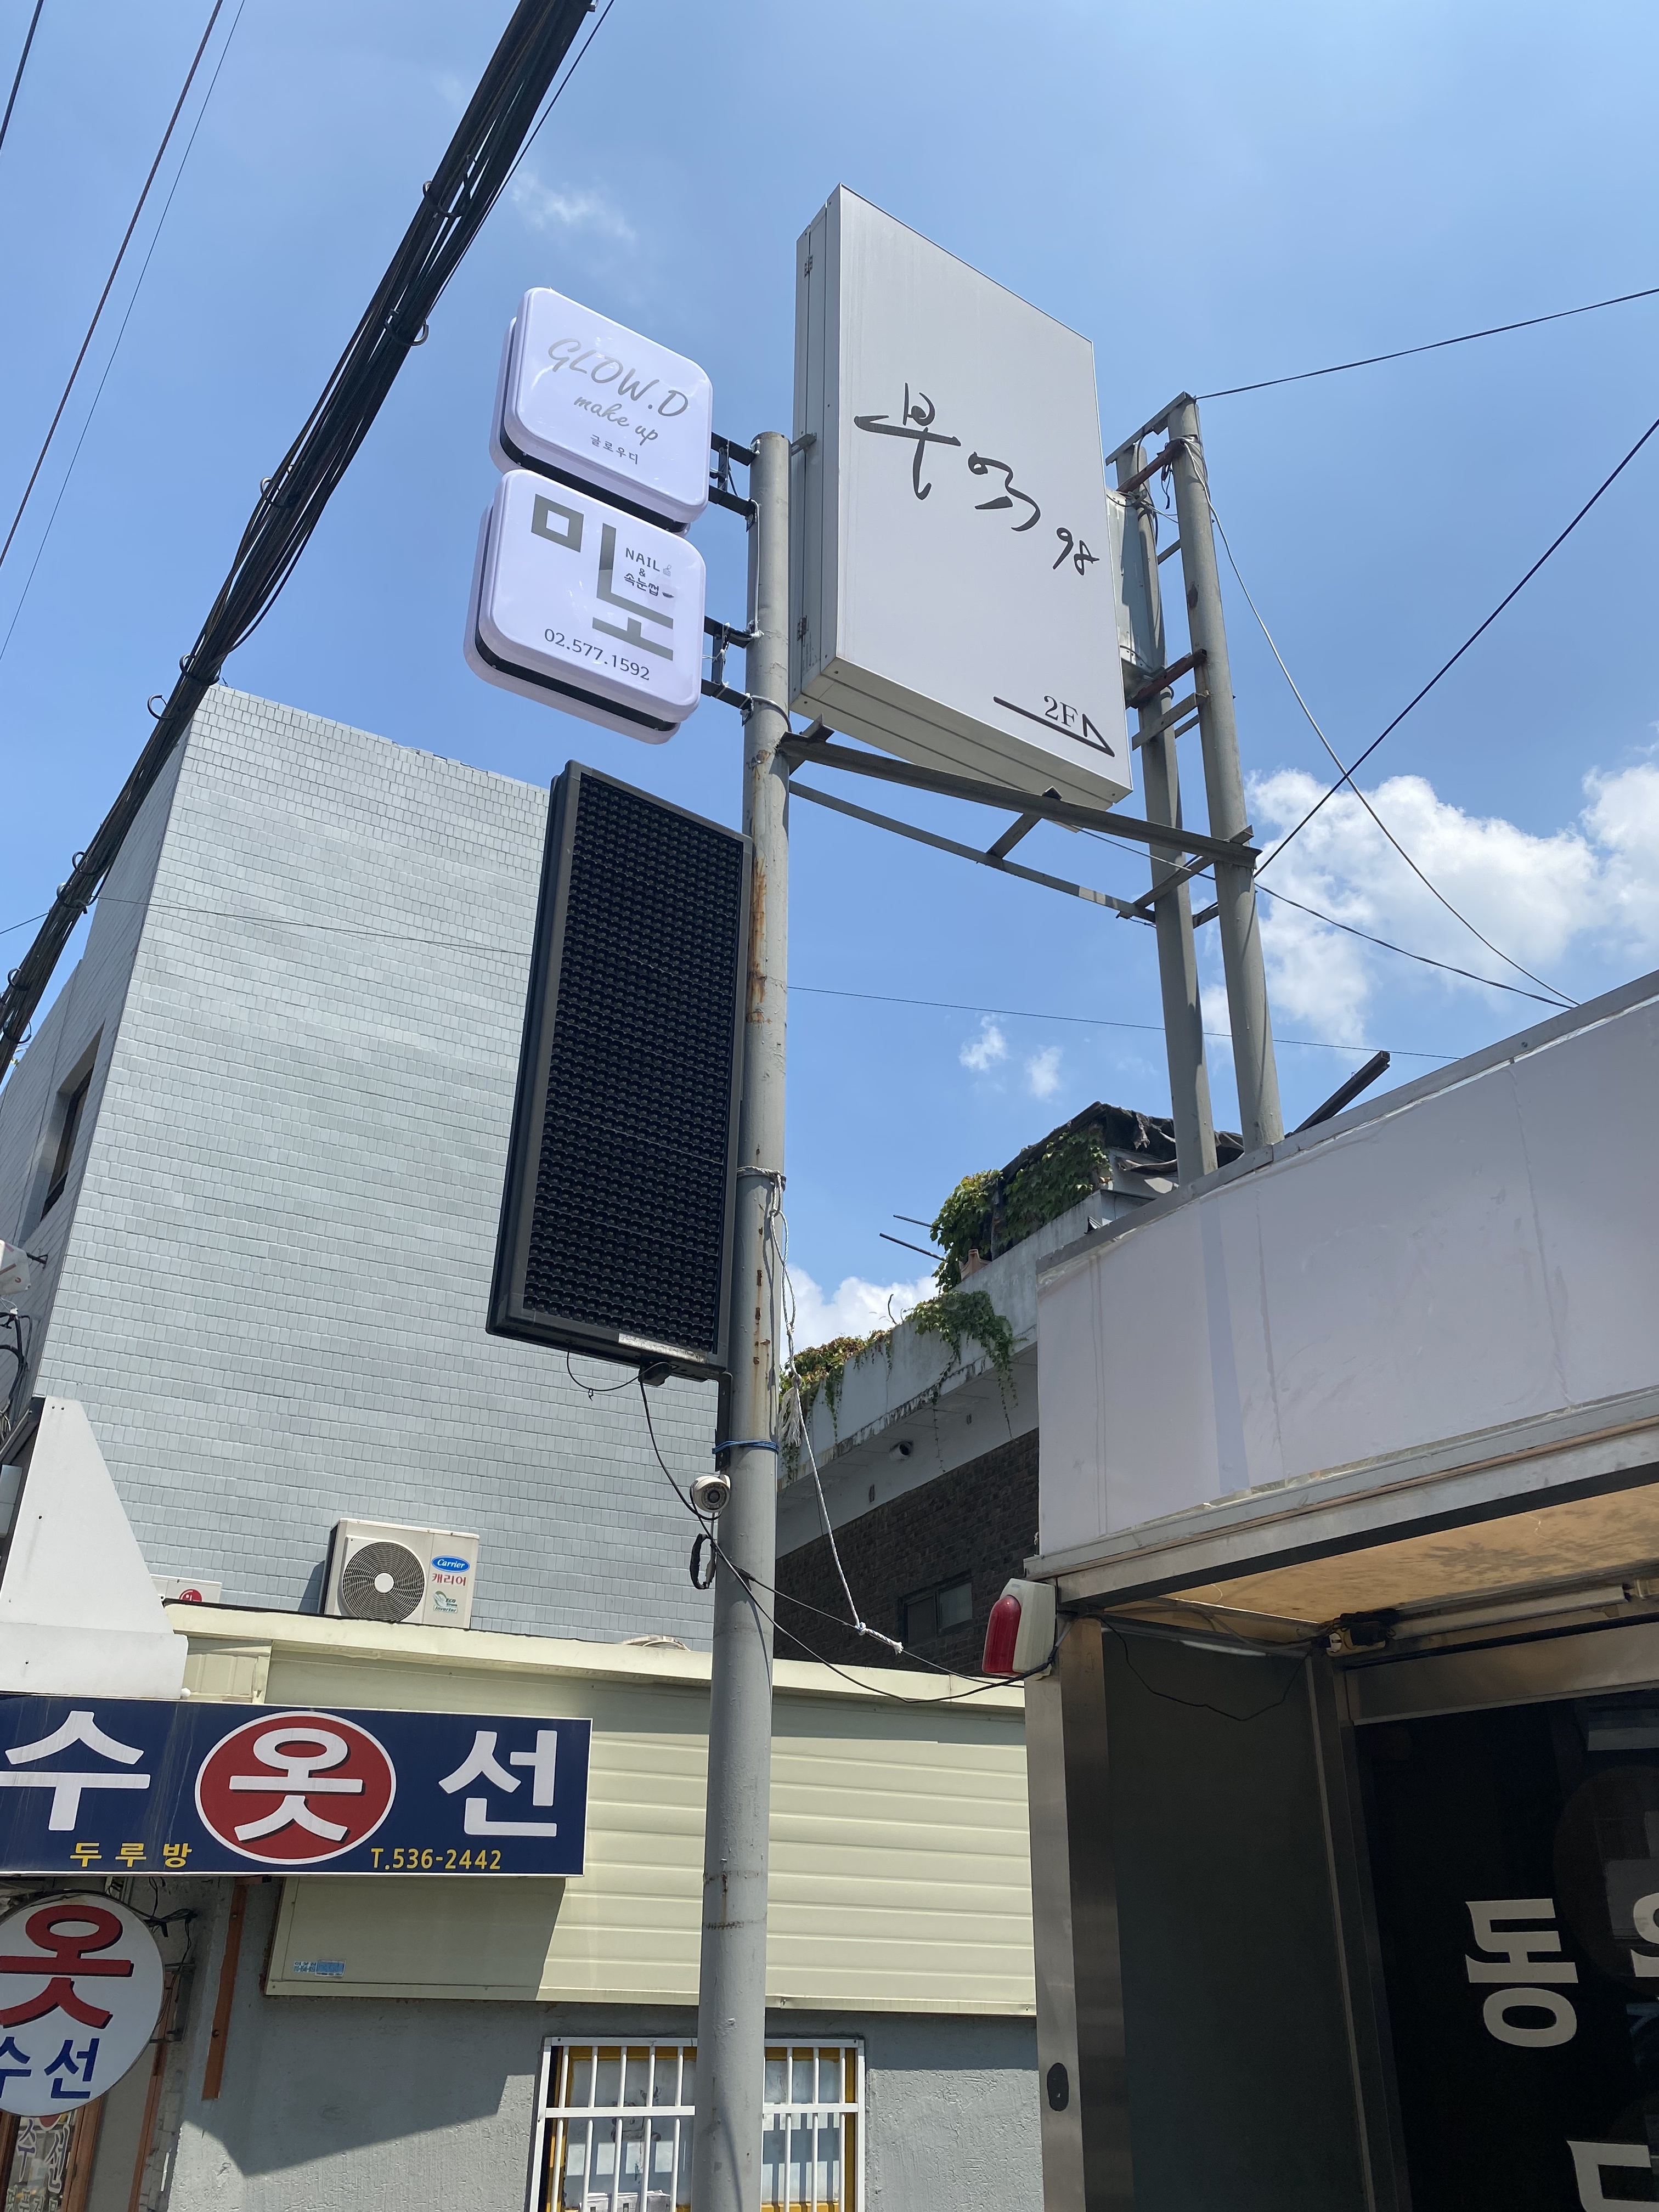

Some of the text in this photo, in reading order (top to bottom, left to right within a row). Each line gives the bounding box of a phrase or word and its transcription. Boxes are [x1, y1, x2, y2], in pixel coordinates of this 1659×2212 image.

[548, 337, 689, 417] GLOW.D
[574, 396, 658, 447] make up
[590, 434, 639, 465] 글로우디
[625, 547, 661, 572] NAIL
[639, 568, 646, 577] &
[624, 573, 659, 597] 속눈썹
[544, 628, 650, 681] 02.577.1592
[1043, 695, 1079, 727] 2F
[437, 1559, 465, 1568] Carrier
[432, 1573, 466, 1586] 캐리어
[370, 1848, 501, 1870] T.536-2442
[0, 1905, 134, 2029] 옷
